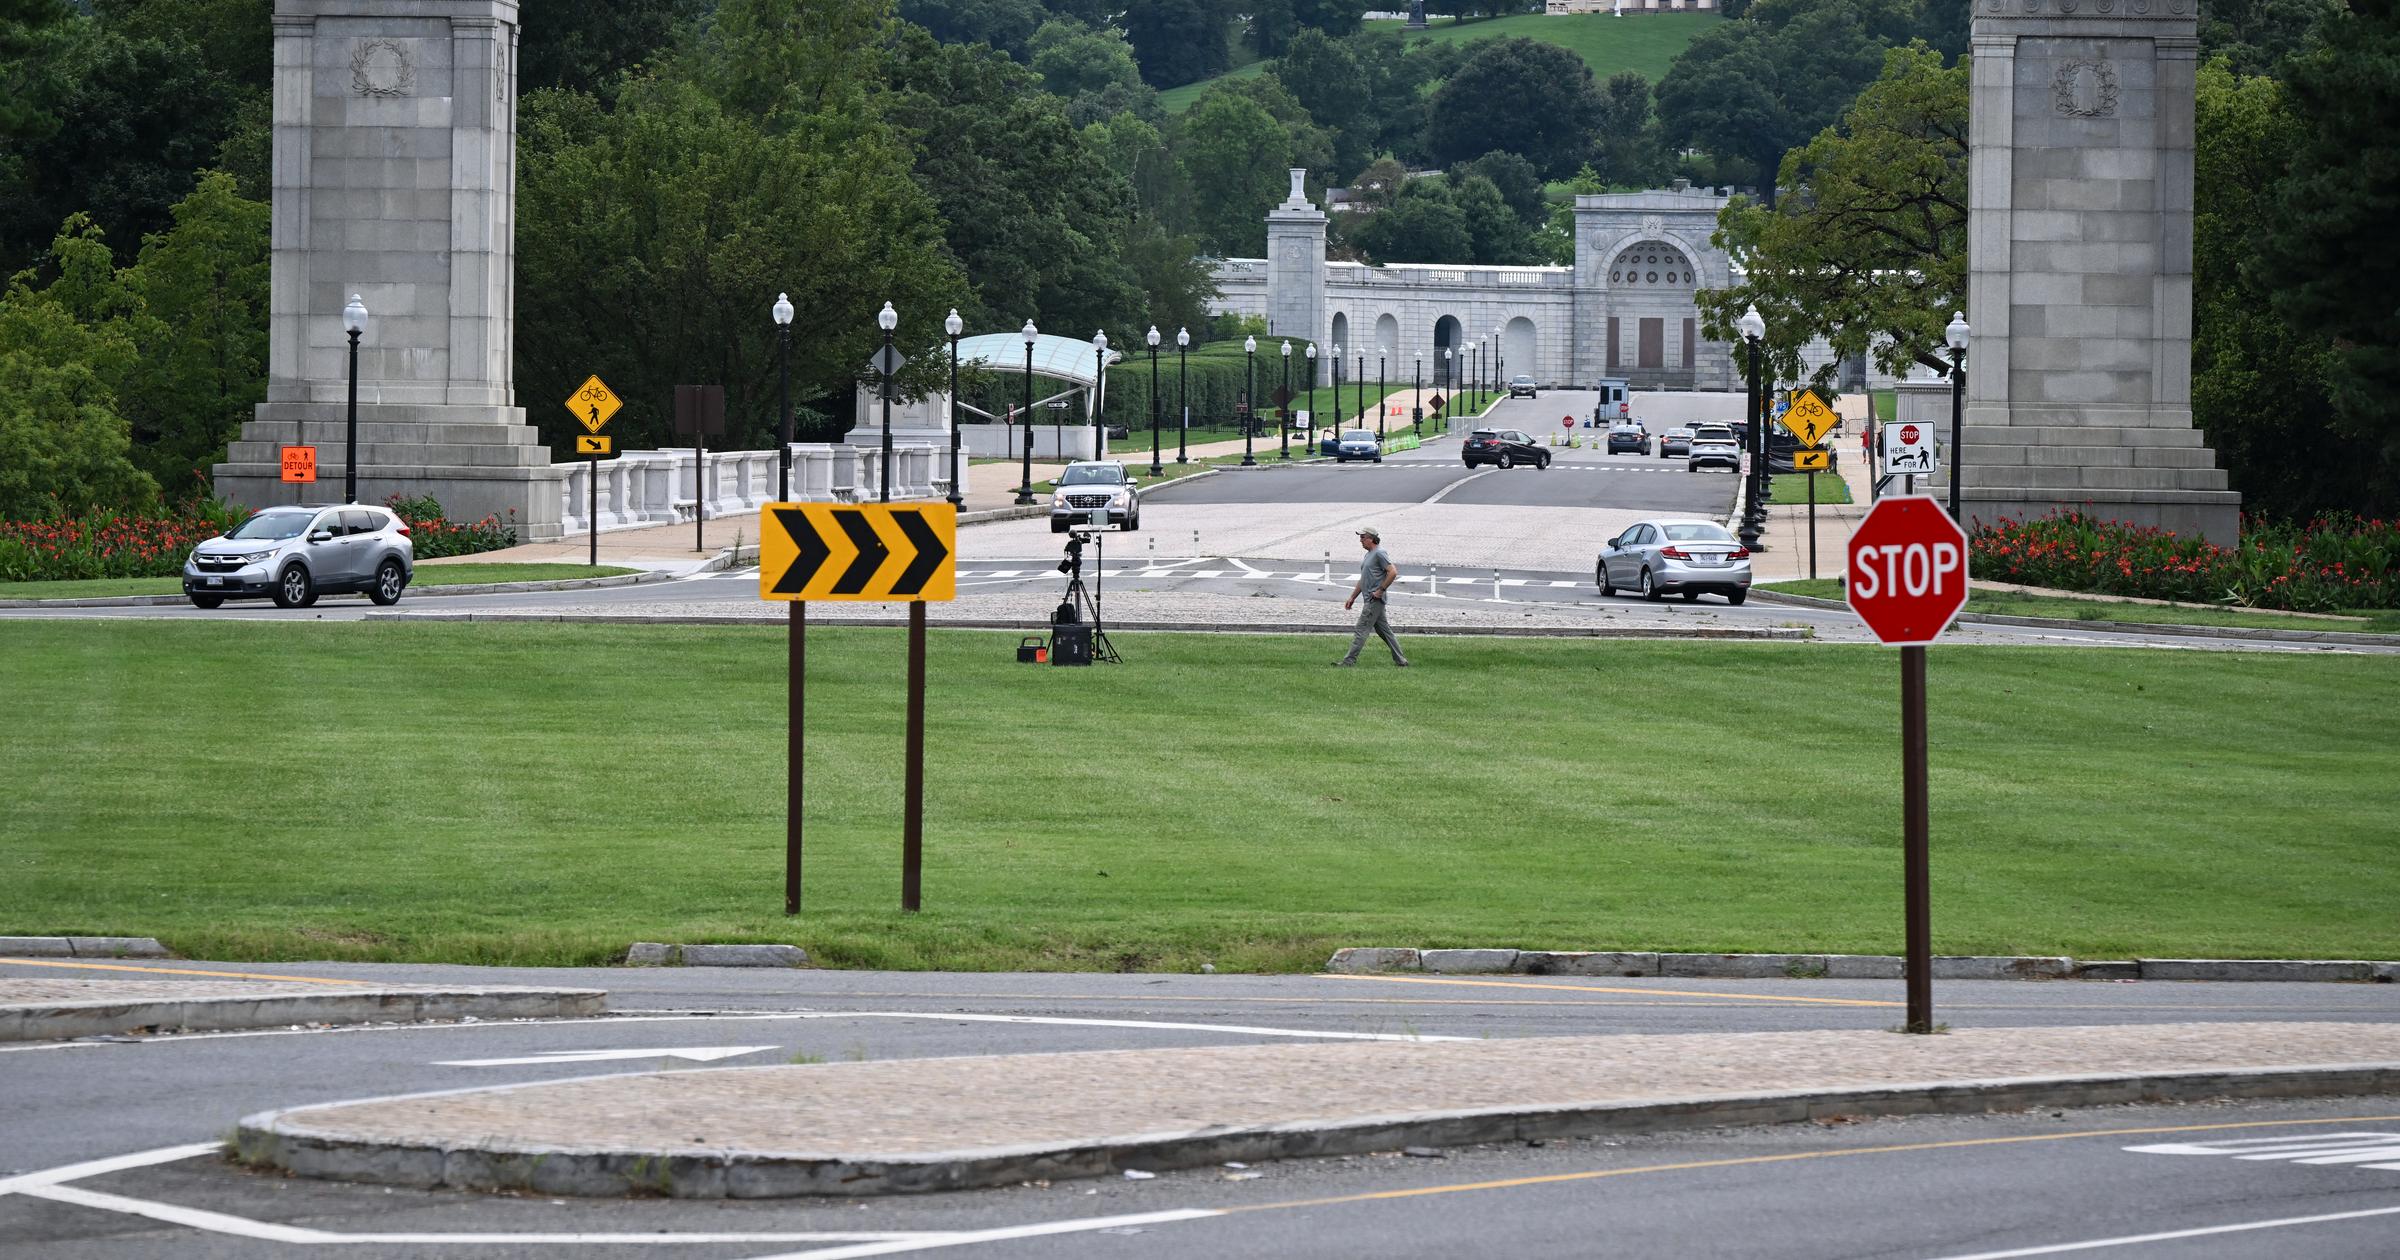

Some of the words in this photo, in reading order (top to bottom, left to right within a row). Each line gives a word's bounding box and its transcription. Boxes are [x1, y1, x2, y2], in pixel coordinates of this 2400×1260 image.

[1900, 431, 1919, 439] STOP
[284, 461, 313, 470] DETOUR
[1855, 542, 1959, 599] STOP
